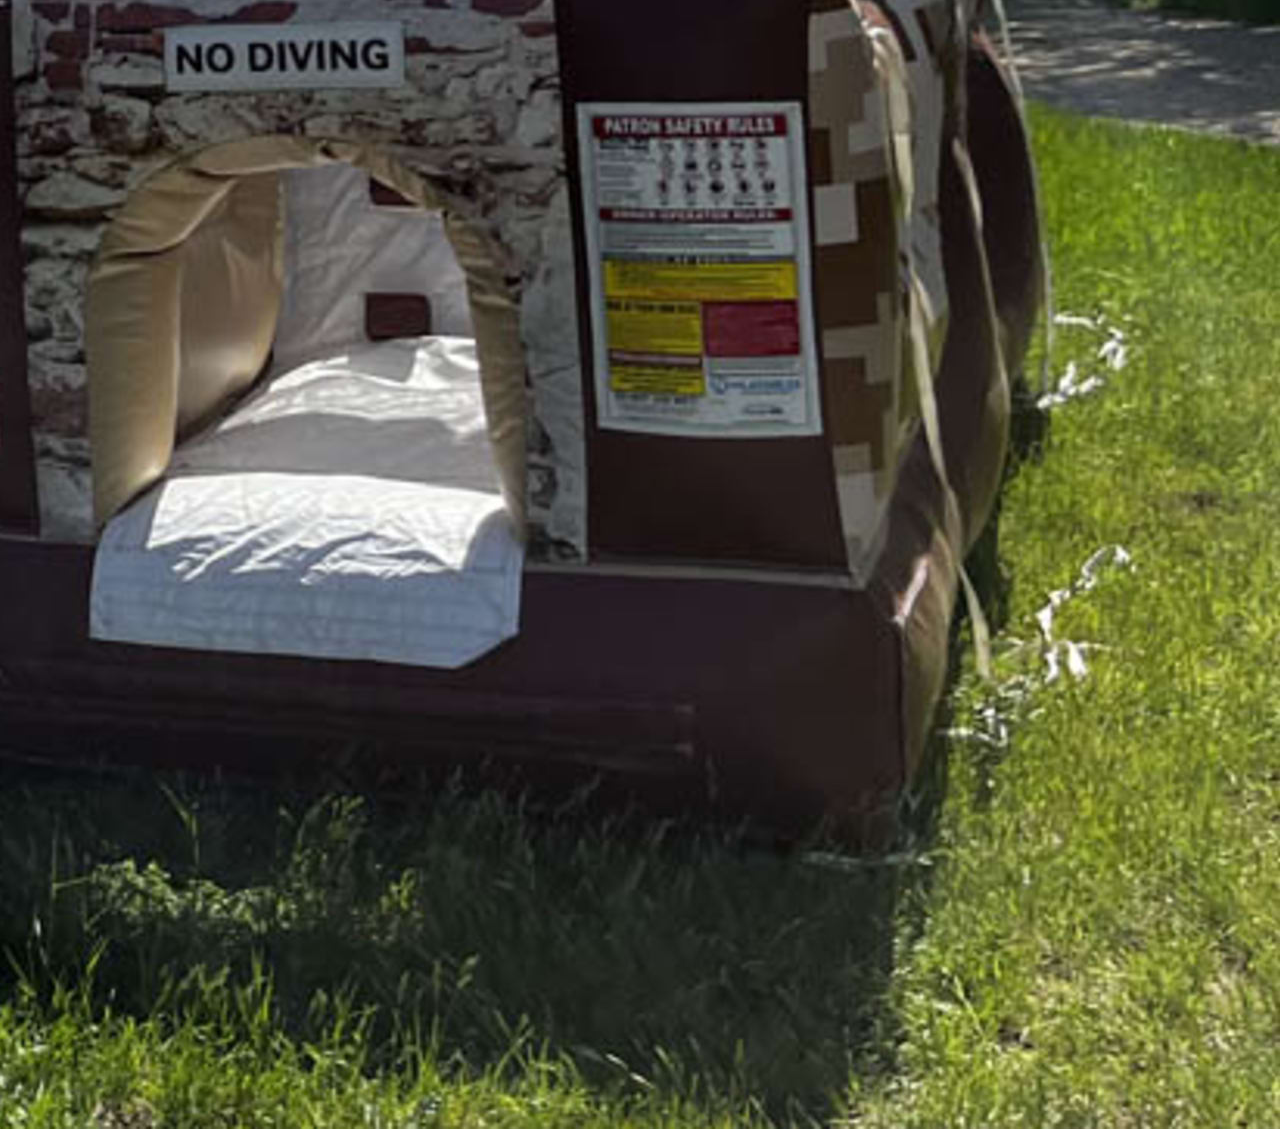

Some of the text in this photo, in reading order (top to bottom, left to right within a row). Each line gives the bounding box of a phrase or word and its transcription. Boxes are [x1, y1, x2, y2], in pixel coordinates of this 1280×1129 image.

[175, 38, 389, 74] NO DIVING
[603, 116, 775, 134] PATRON SAFETY RULES
